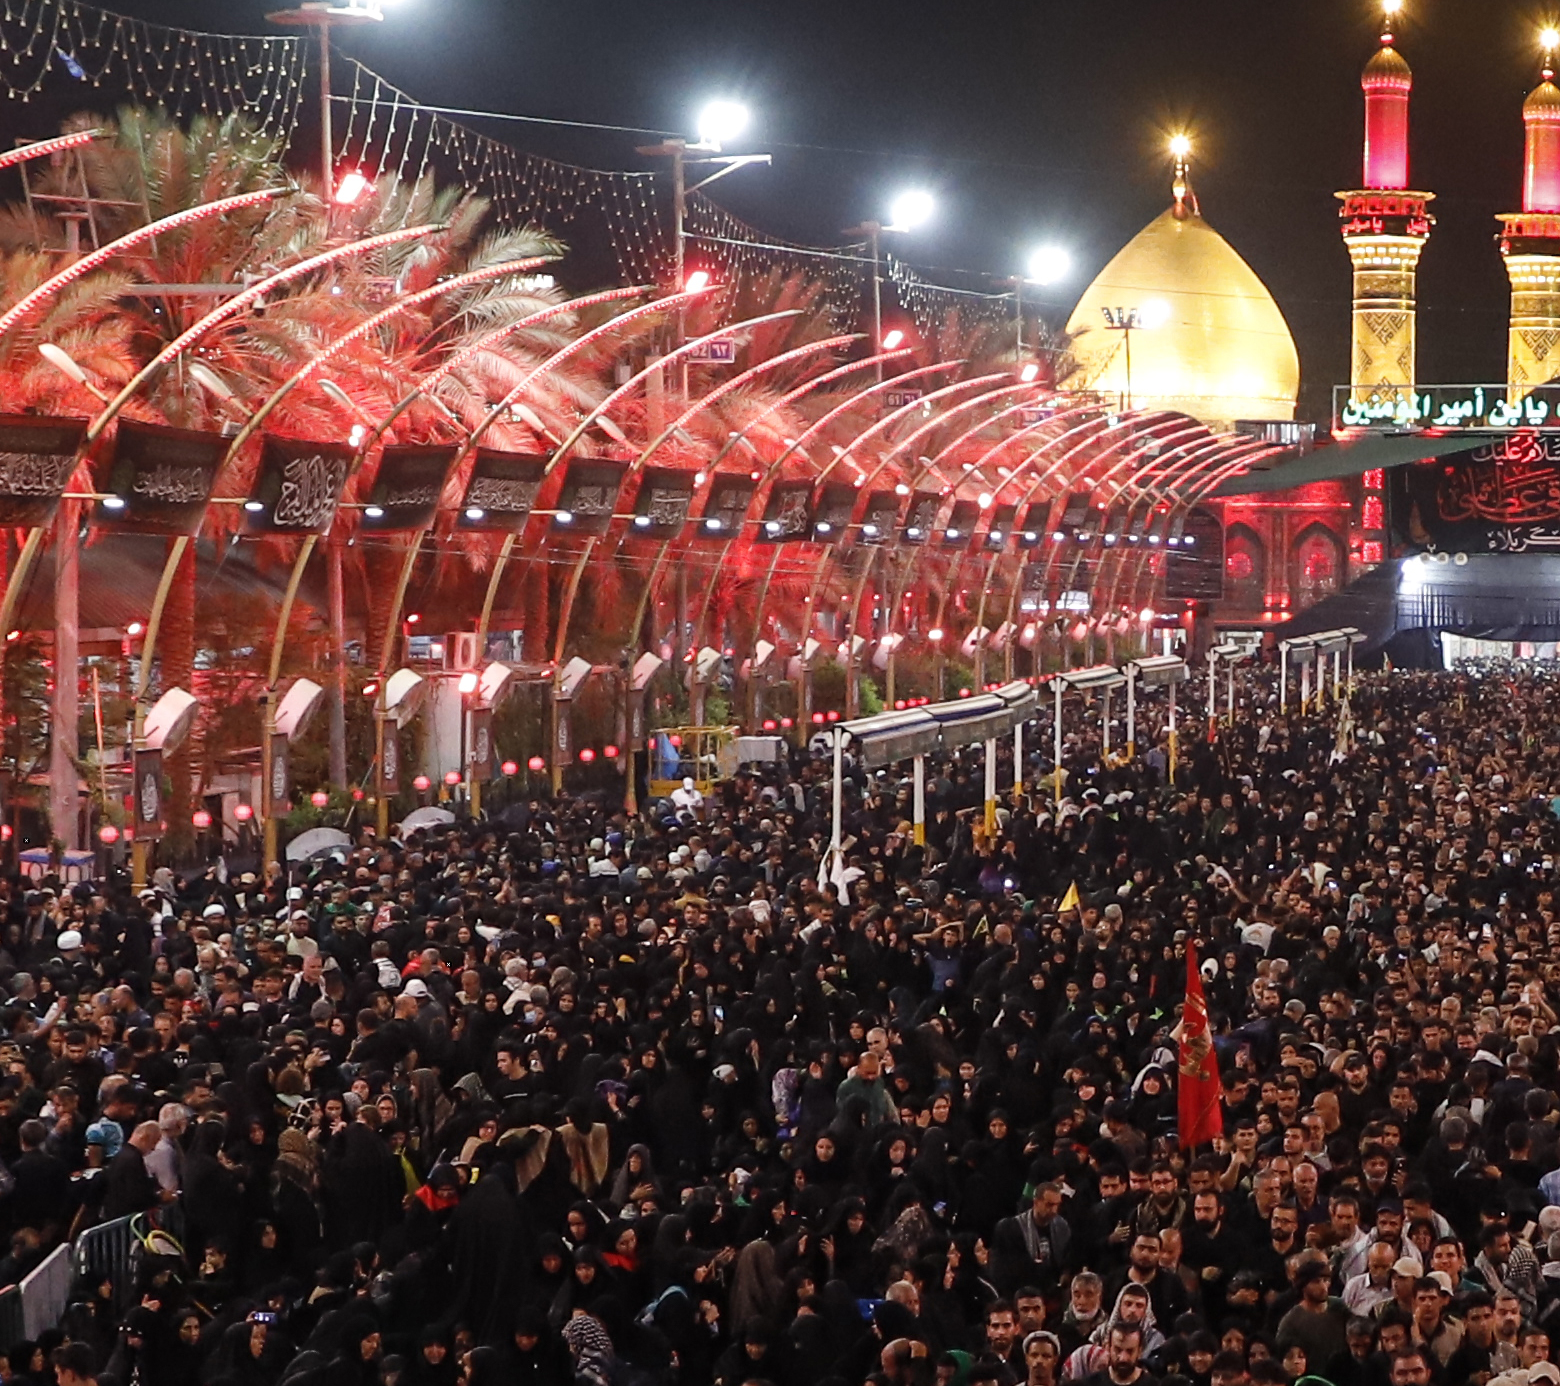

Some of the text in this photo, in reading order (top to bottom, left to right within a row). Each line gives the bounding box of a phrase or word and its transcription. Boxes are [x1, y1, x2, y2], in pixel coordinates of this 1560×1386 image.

[1341, 393, 1431, 426] المؤمنين
[1438, 387, 1484, 426] أمير
[1488, 397, 1548, 427] يابن
